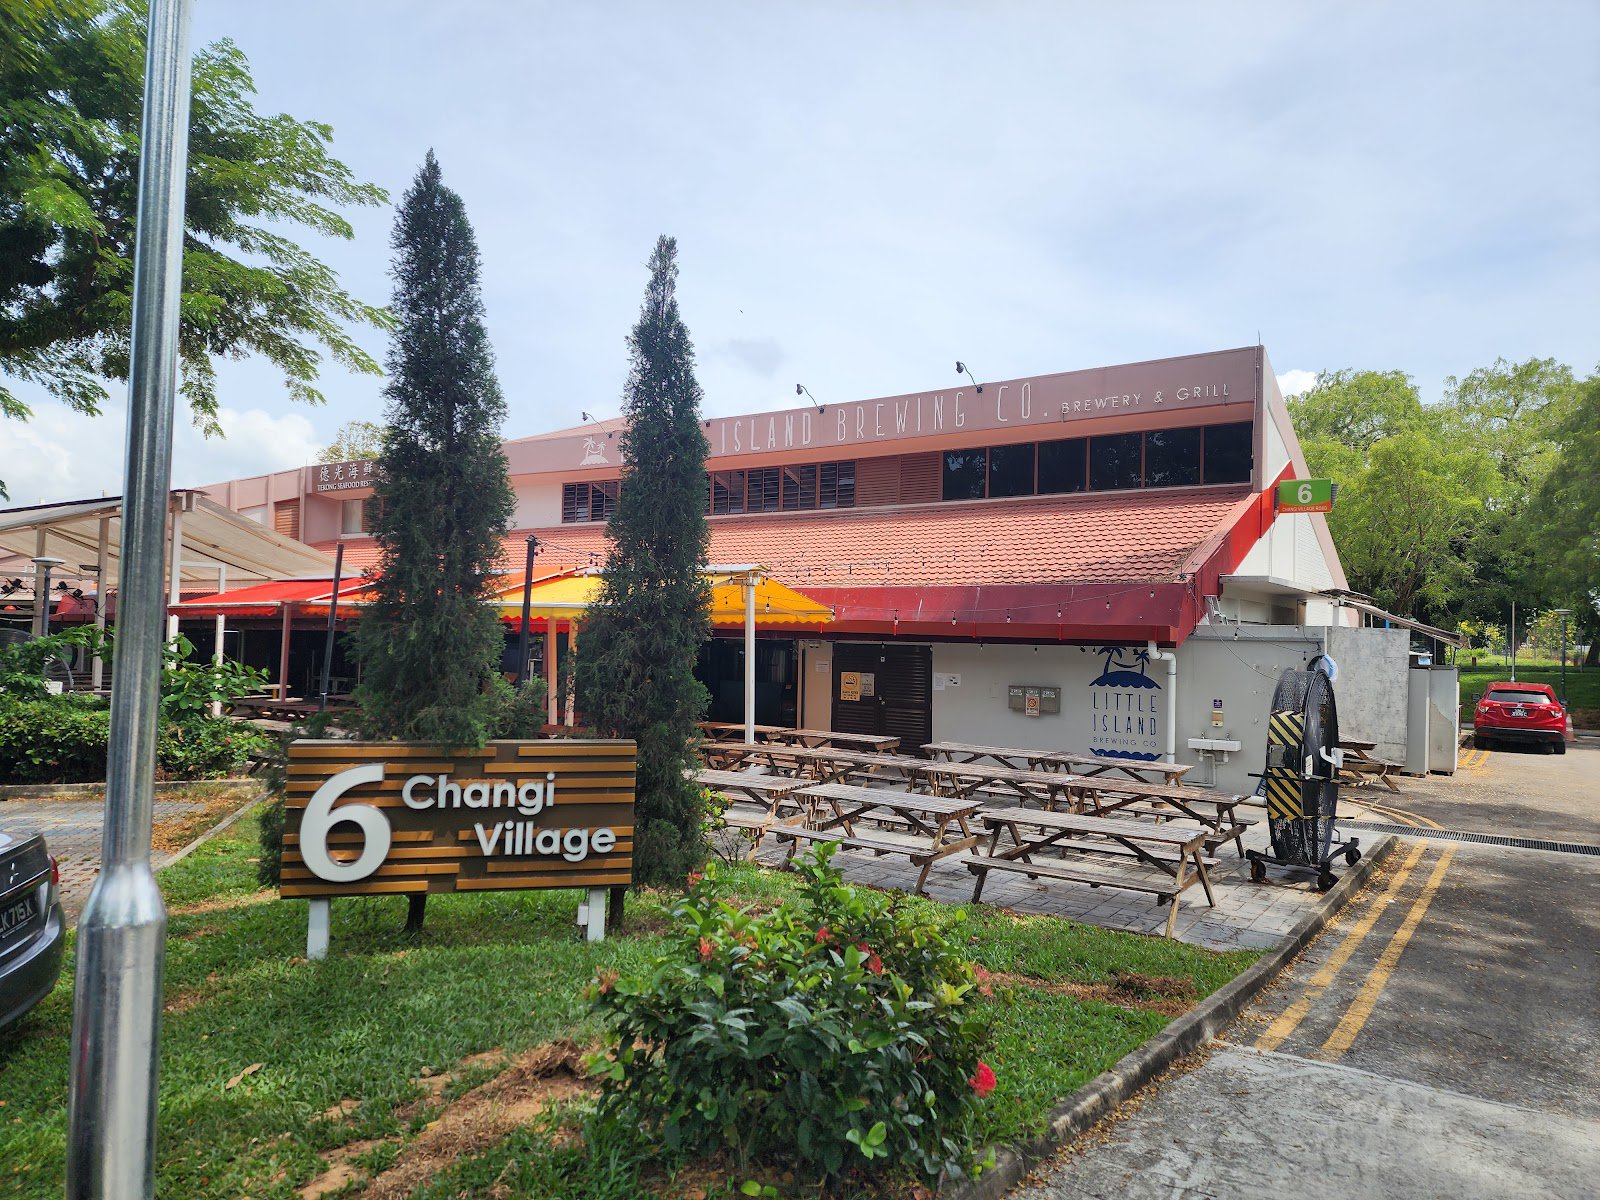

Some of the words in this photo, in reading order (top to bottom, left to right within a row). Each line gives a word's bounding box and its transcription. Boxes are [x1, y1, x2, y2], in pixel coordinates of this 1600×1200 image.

[1061, 393, 1142, 414] BREWERY
[1153, 391, 1163, 404] &
[1176, 384, 1229, 401] GRILL
[721, 412, 812, 453] ISLAND
[837, 392, 966, 441] BREWING
[997, 382, 1048, 421] CO.
[337, 481, 360, 490] SEAFOOD
[1298, 483, 1313, 504] 6
[1093, 692, 1157, 712] LITTLE
[1093, 713, 1156, 735] ISLAND
[1093, 736, 1137, 746] BREWING
[1142, 740, 1157, 748] CO
[401, 772, 556, 816] Changi
[299, 762, 392, 883] 6
[474, 820, 617, 862] Village
